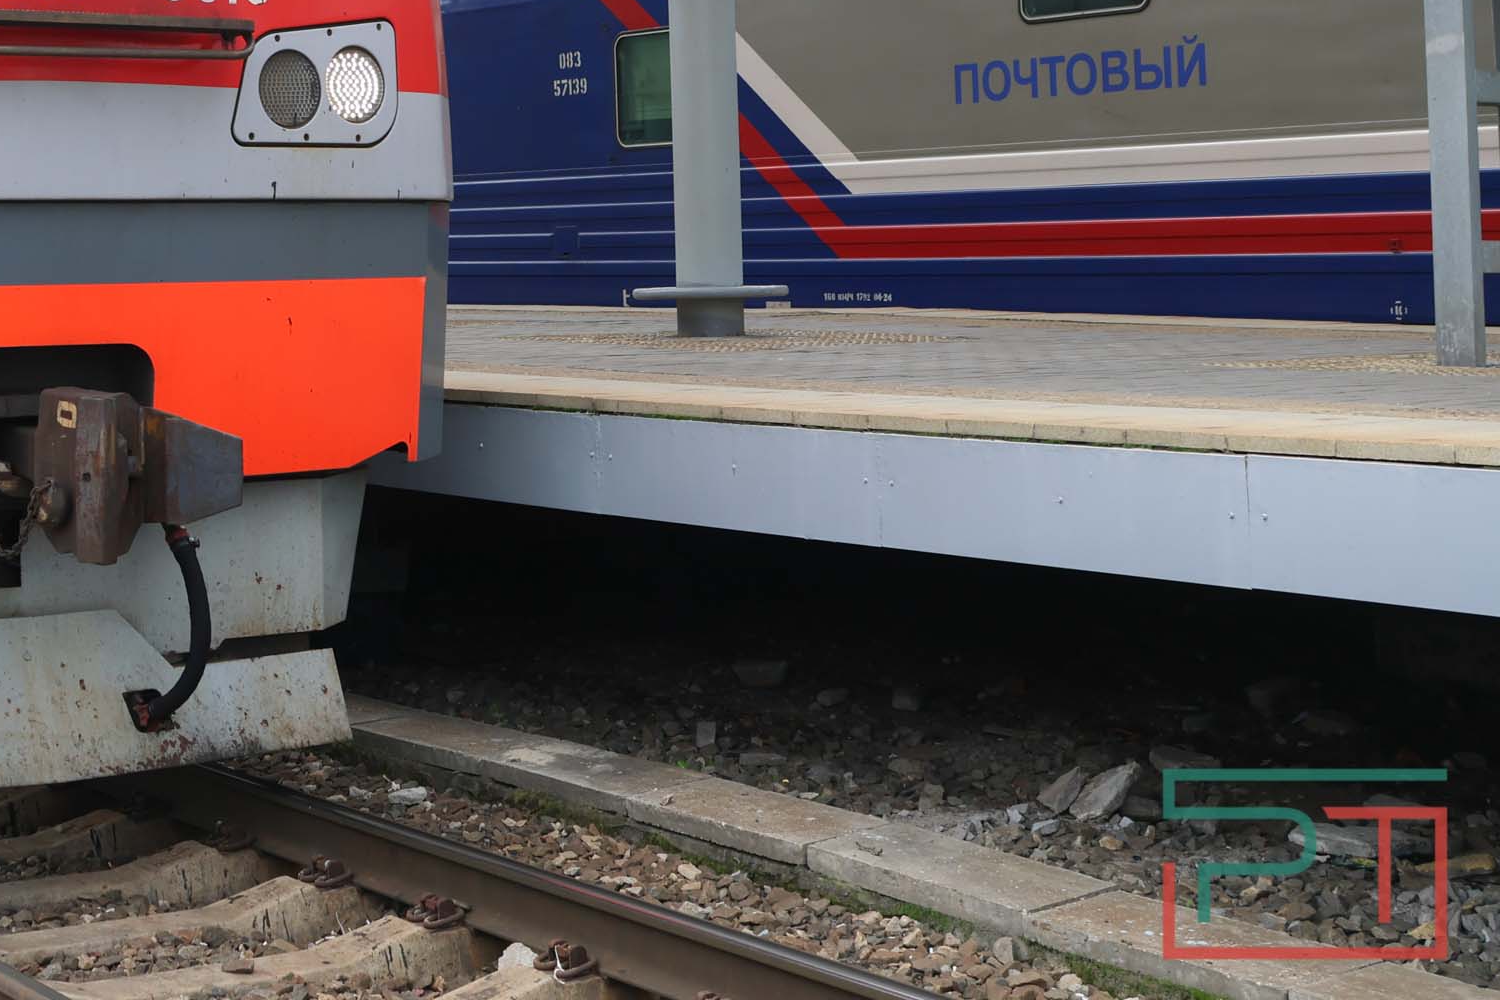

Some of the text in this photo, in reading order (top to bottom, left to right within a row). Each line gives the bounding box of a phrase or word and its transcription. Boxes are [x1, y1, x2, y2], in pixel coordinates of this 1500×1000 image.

[558, 51, 582, 70] 083
[953, 33, 1208, 105] ПОЧТОВЫЙ
[553, 77, 588, 97] 57139
